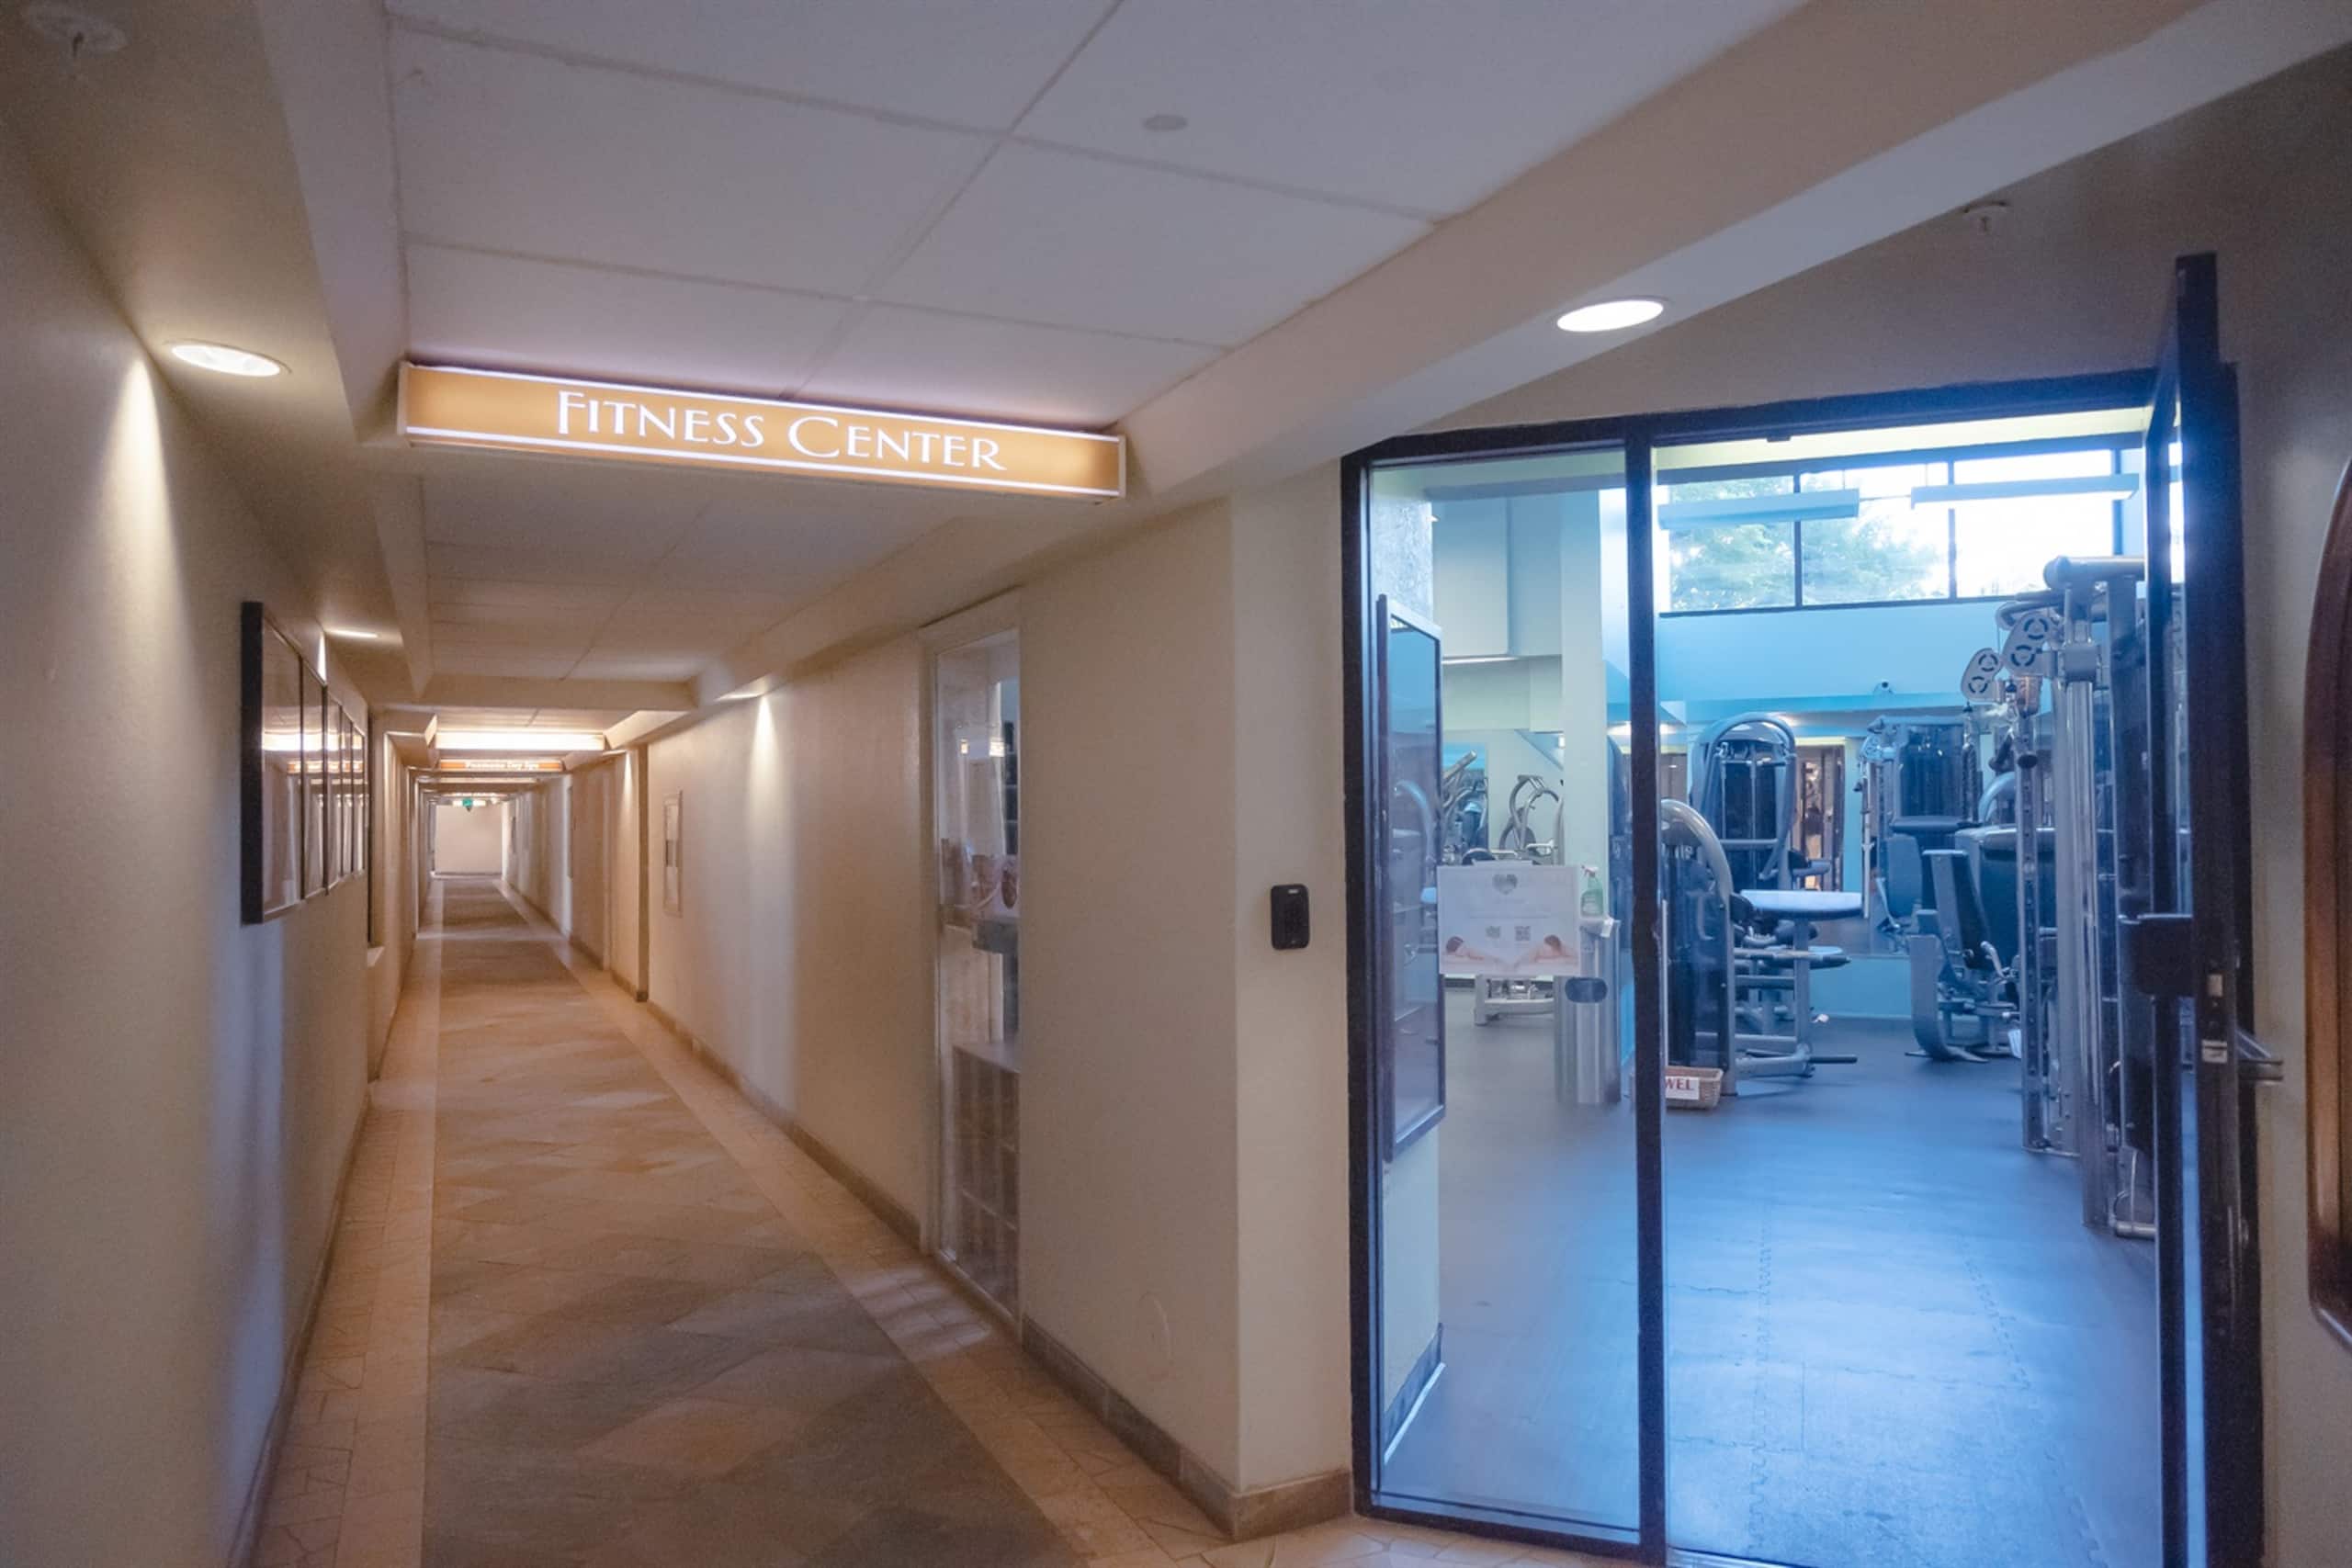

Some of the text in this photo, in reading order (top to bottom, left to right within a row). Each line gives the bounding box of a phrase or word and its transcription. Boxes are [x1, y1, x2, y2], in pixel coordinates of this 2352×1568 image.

[558, 389, 1007, 471] FITNESS CENTER
[1665, 1077, 1693, 1090] WEL
